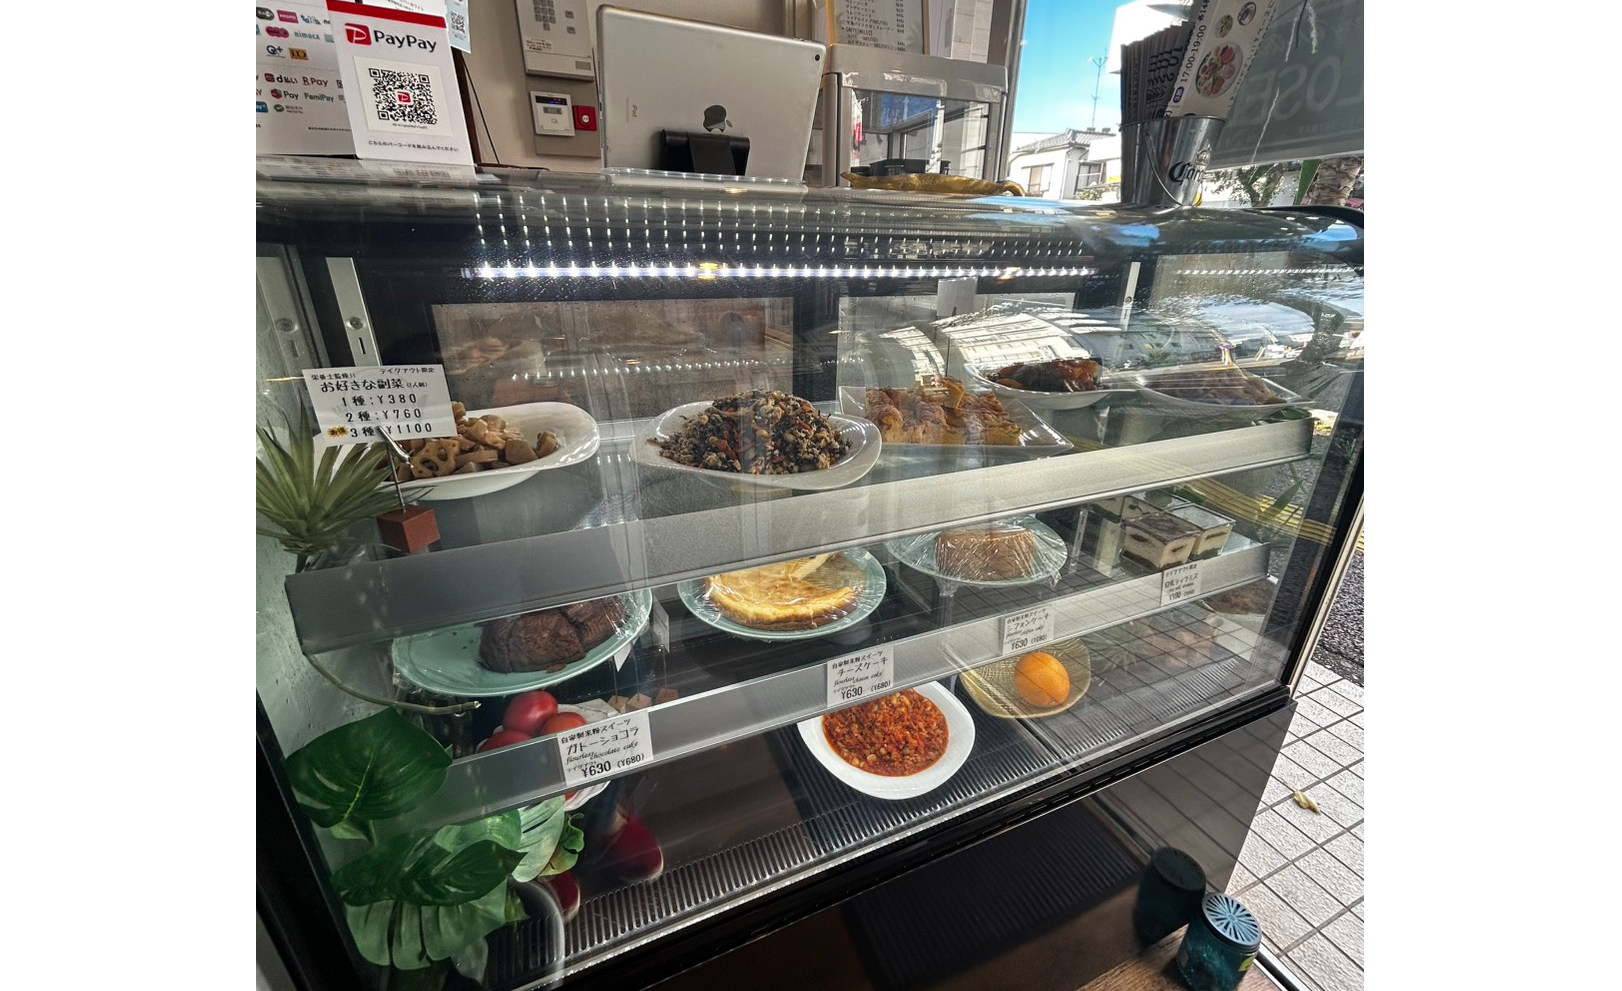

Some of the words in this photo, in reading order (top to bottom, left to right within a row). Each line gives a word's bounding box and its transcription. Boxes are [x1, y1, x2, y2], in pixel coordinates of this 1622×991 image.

[373, 30, 437, 53] PayPay
[1181, 25, 1207, 82] 17:00-19:00
[311, 77, 328, 87] Pay
[283, 90, 299, 101] Pay
[304, 92, 335, 102] FamiPay
[379, 367, 435, 375] テイクアウト限定
[320, 378, 405, 393] お好きな副菜
[841, 686, 863, 700] ¥630
[870, 680, 891, 692] (¥680)
[561, 718, 631, 744] 自家製米粉スイーツ
[567, 726, 639, 755] ガトーショコラ
[623, 741, 639, 750] cake
[581, 760, 612, 778] ¥630
[617, 753, 645, 768] (¥680)
